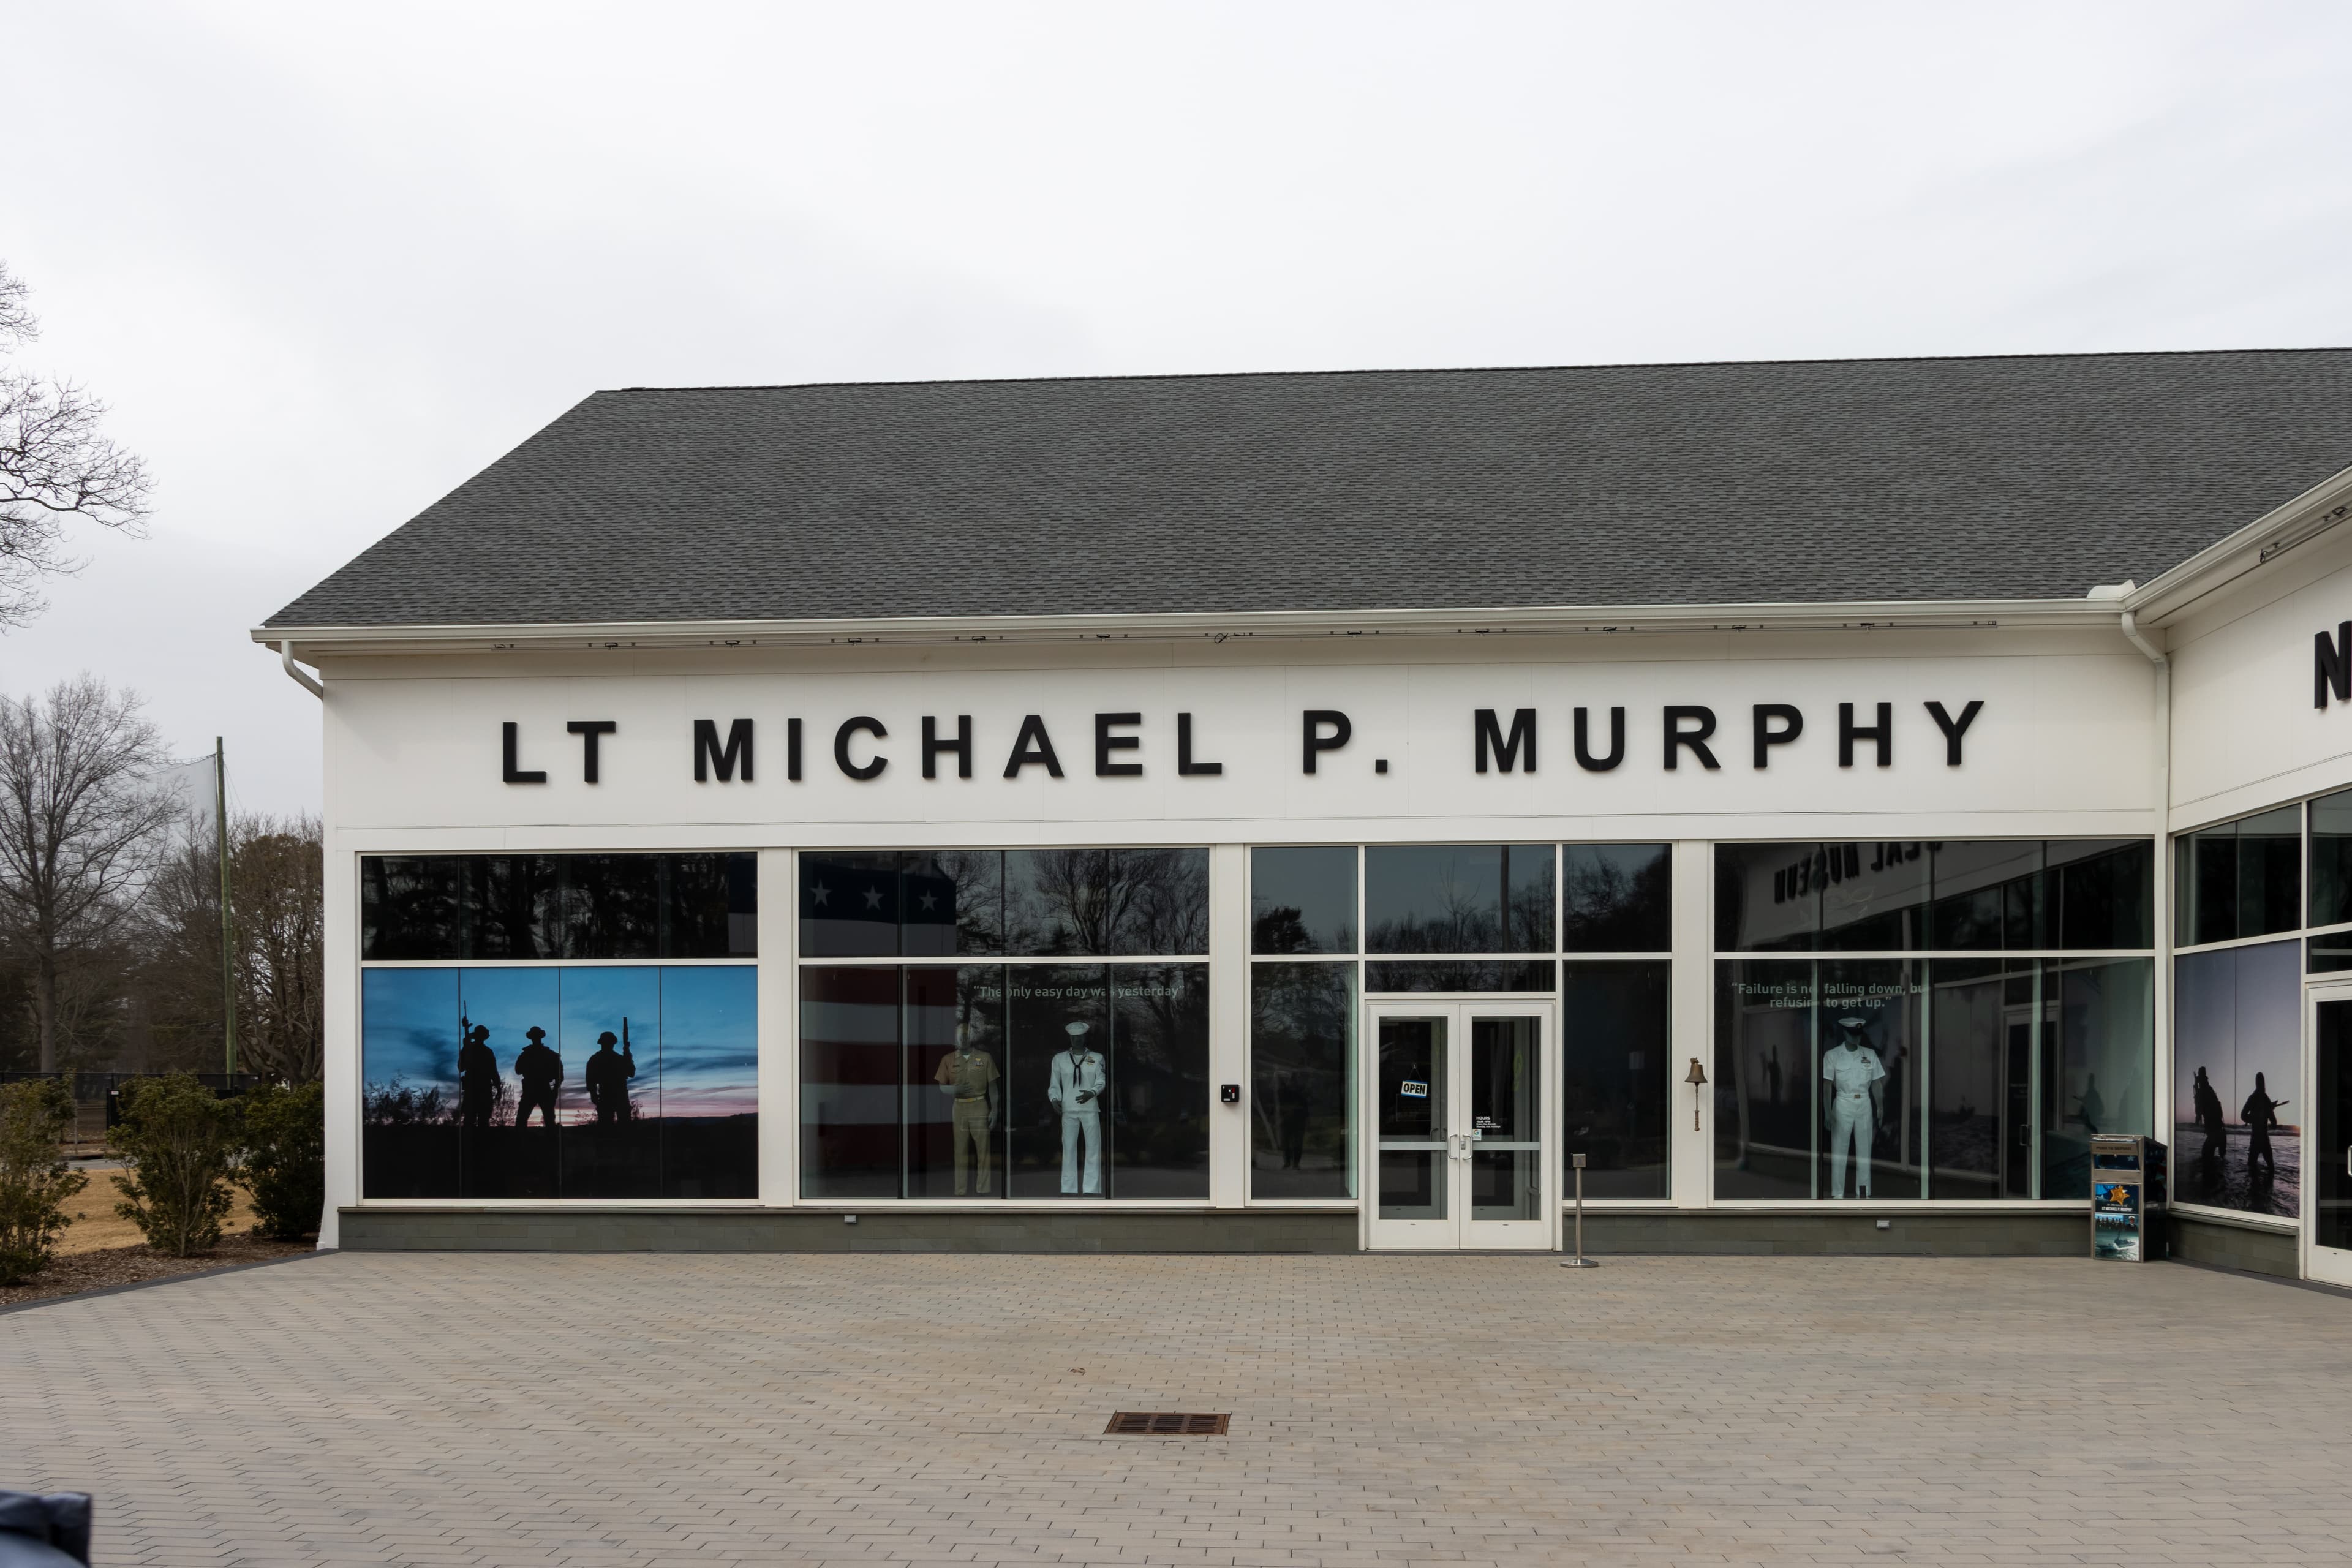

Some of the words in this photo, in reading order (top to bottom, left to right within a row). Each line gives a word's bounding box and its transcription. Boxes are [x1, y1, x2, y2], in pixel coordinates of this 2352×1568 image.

[502, 720, 617, 785] LT
[693, 712, 1224, 783] MICHAEL
[1302, 709, 1389, 775] P.
[1473, 700, 1986, 774] MURPHY
[1035, 987, 1063, 999] easy
[1066, 986, 1088, 999] day
[1118, 985, 1185, 998] yesterday”
[1787, 983, 1797, 994] is
[1824, 983, 1865, 996] falling
[1868, 983, 1906, 995] down,
[1825, 998, 1838, 1008] to
[1842, 998, 1863, 1010] get
[1403, 1082, 1427, 1095] OPEN
